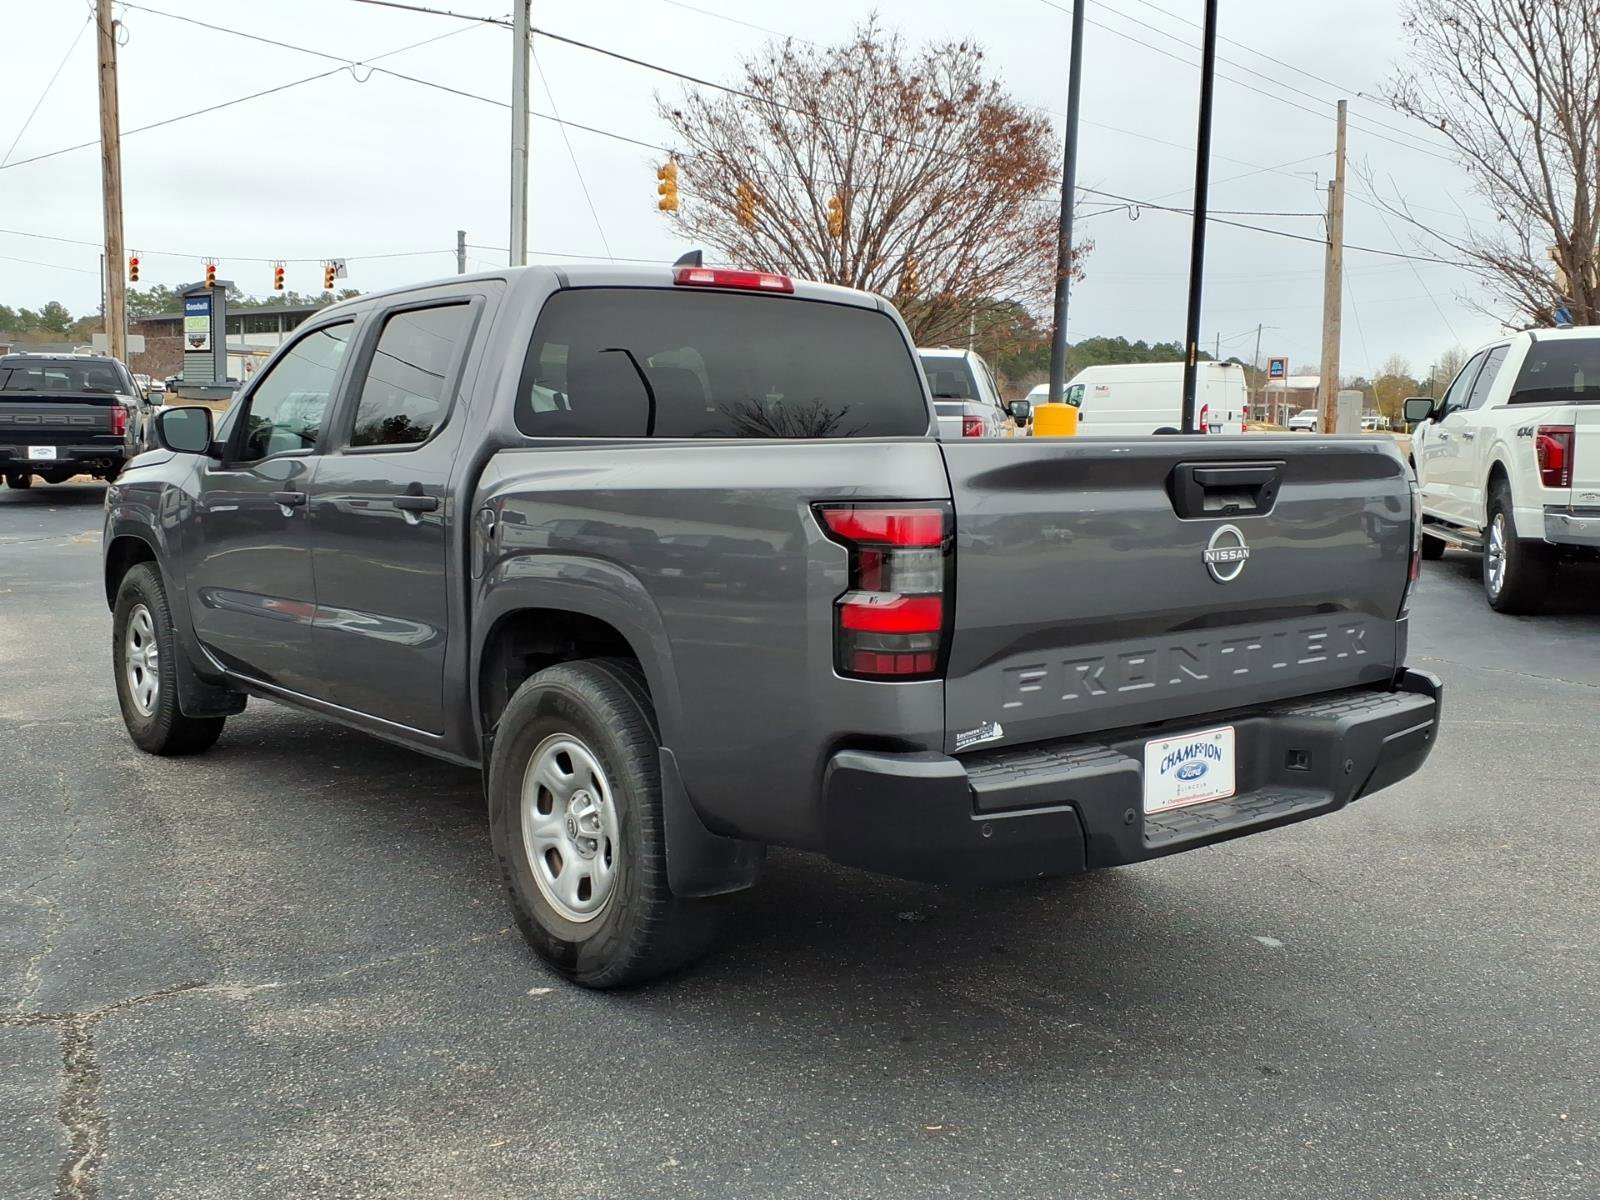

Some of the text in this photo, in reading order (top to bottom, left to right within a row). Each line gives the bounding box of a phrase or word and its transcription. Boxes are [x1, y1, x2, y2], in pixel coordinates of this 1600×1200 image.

[1206, 550, 1249, 560] NISSAN
[1003, 621, 1368, 708] FRONTIER
[1160, 742, 1222, 775] CHAMPION
[1180, 763, 1204, 779] Ford
